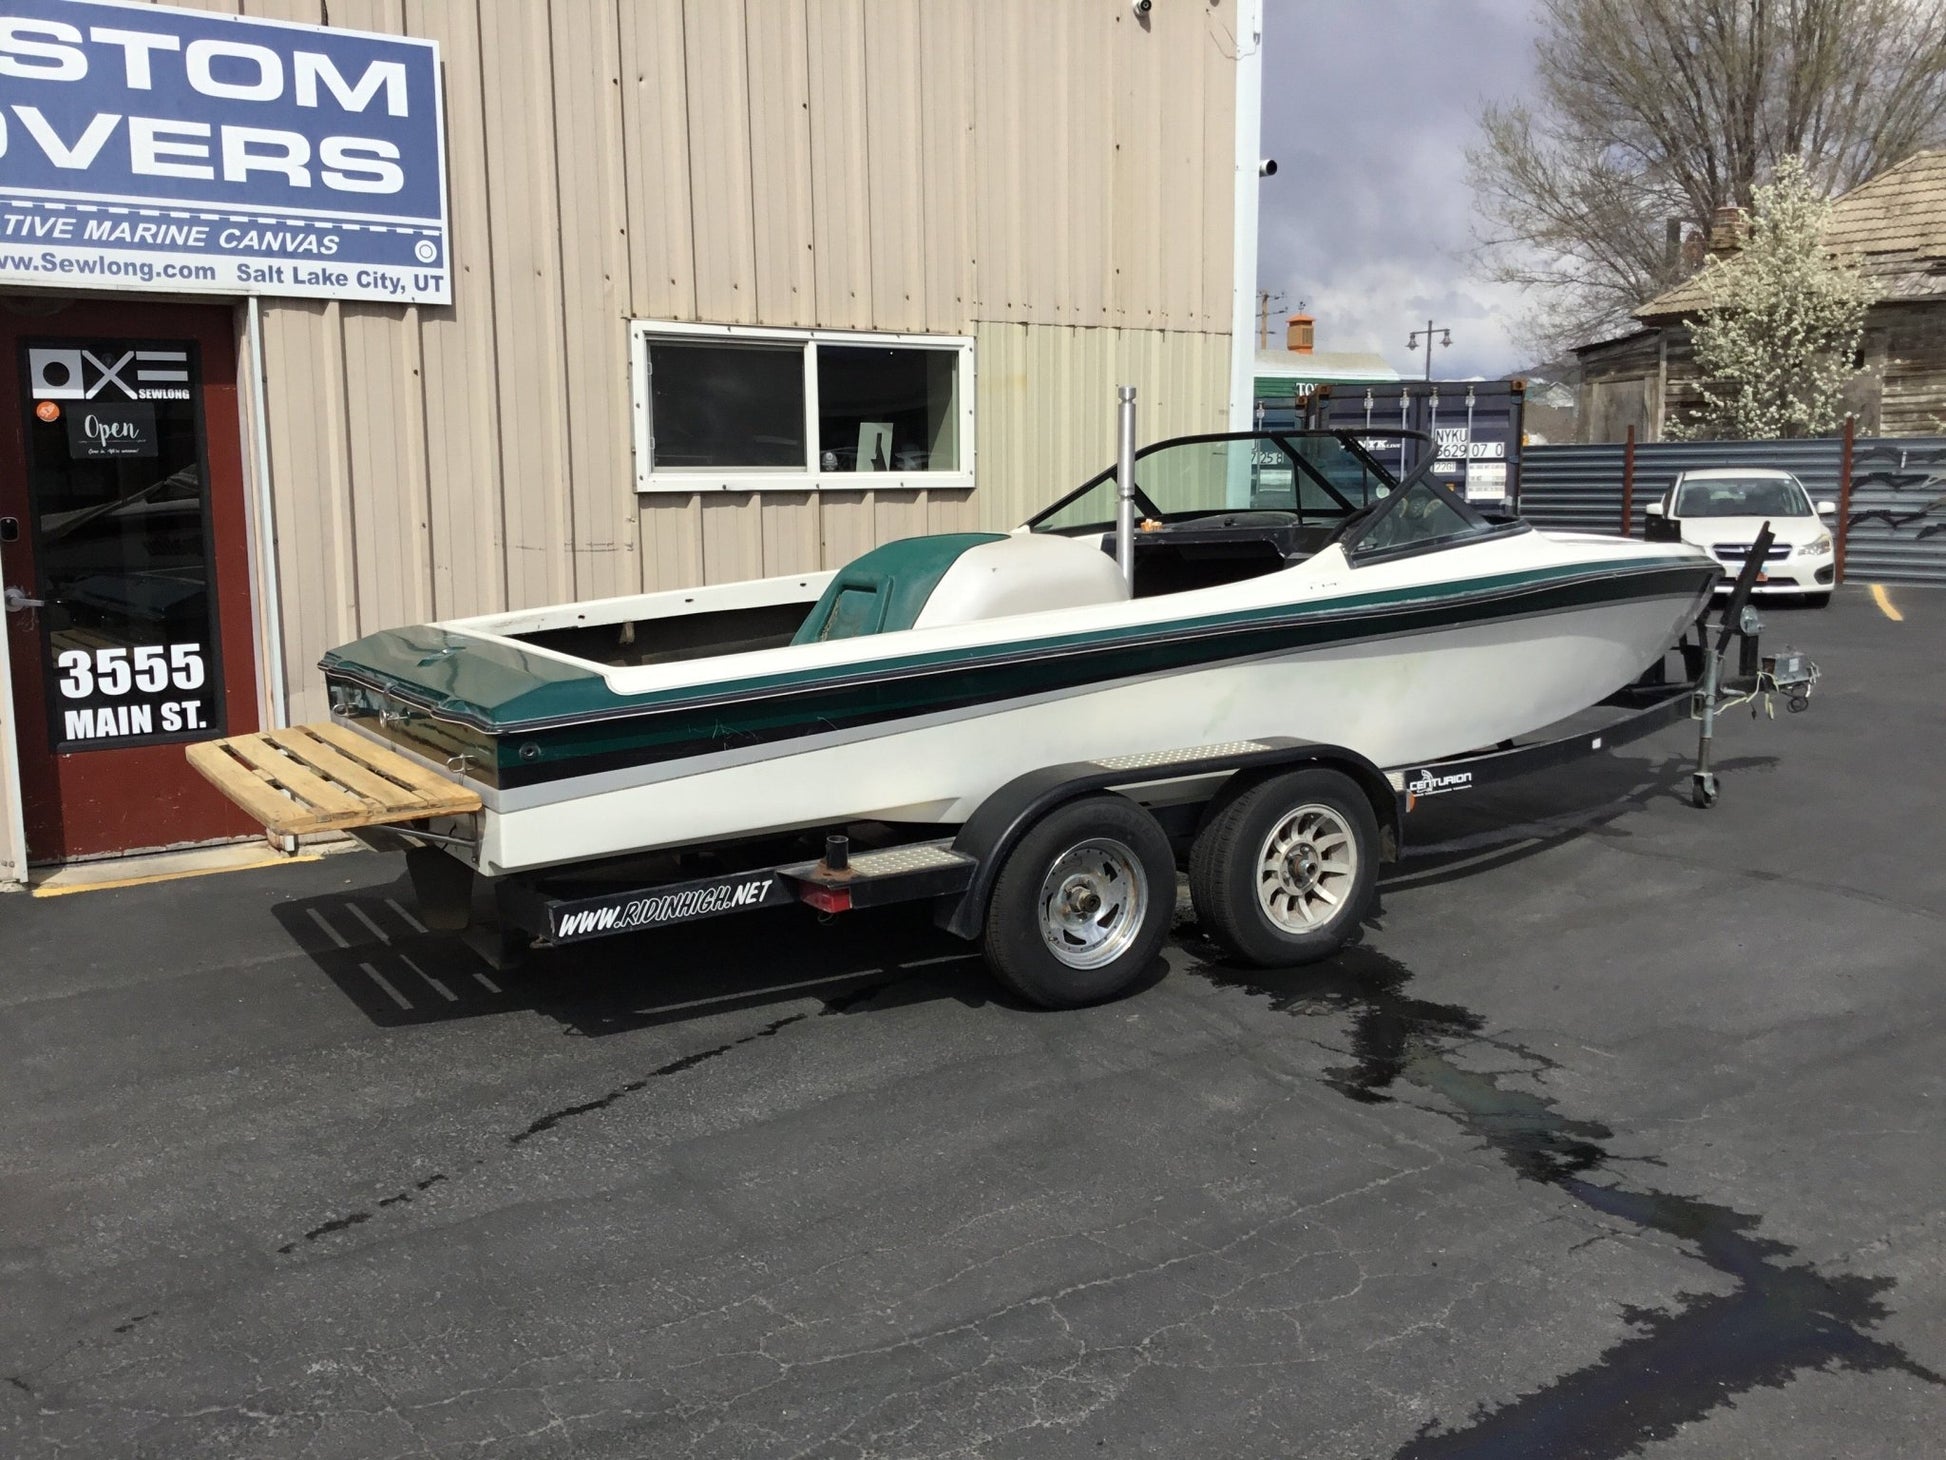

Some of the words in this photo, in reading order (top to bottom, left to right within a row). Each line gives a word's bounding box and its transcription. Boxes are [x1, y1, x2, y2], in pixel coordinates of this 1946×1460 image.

[0, 105, 405, 194] VERS
[4, 214, 77, 239] TIVE
[83, 219, 210, 247] MARINE
[218, 228, 340, 255] CANVAS
[236, 263, 285, 284] Salt
[292, 266, 349, 287] Lake
[356, 270, 406, 295] City,
[414, 273, 444, 292] UT
[138, 388, 190, 400] SEWLONG
[1295, 382, 1319, 396] TO
[84, 414, 140, 447] Open
[1436, 429, 1467, 443] NYKU
[57, 643, 205, 699] 3555
[64, 703, 153, 740] MAIN
[161, 700, 207, 730] ST.
[558, 879, 773, 938] WWW.RIDINHIGH.NET
